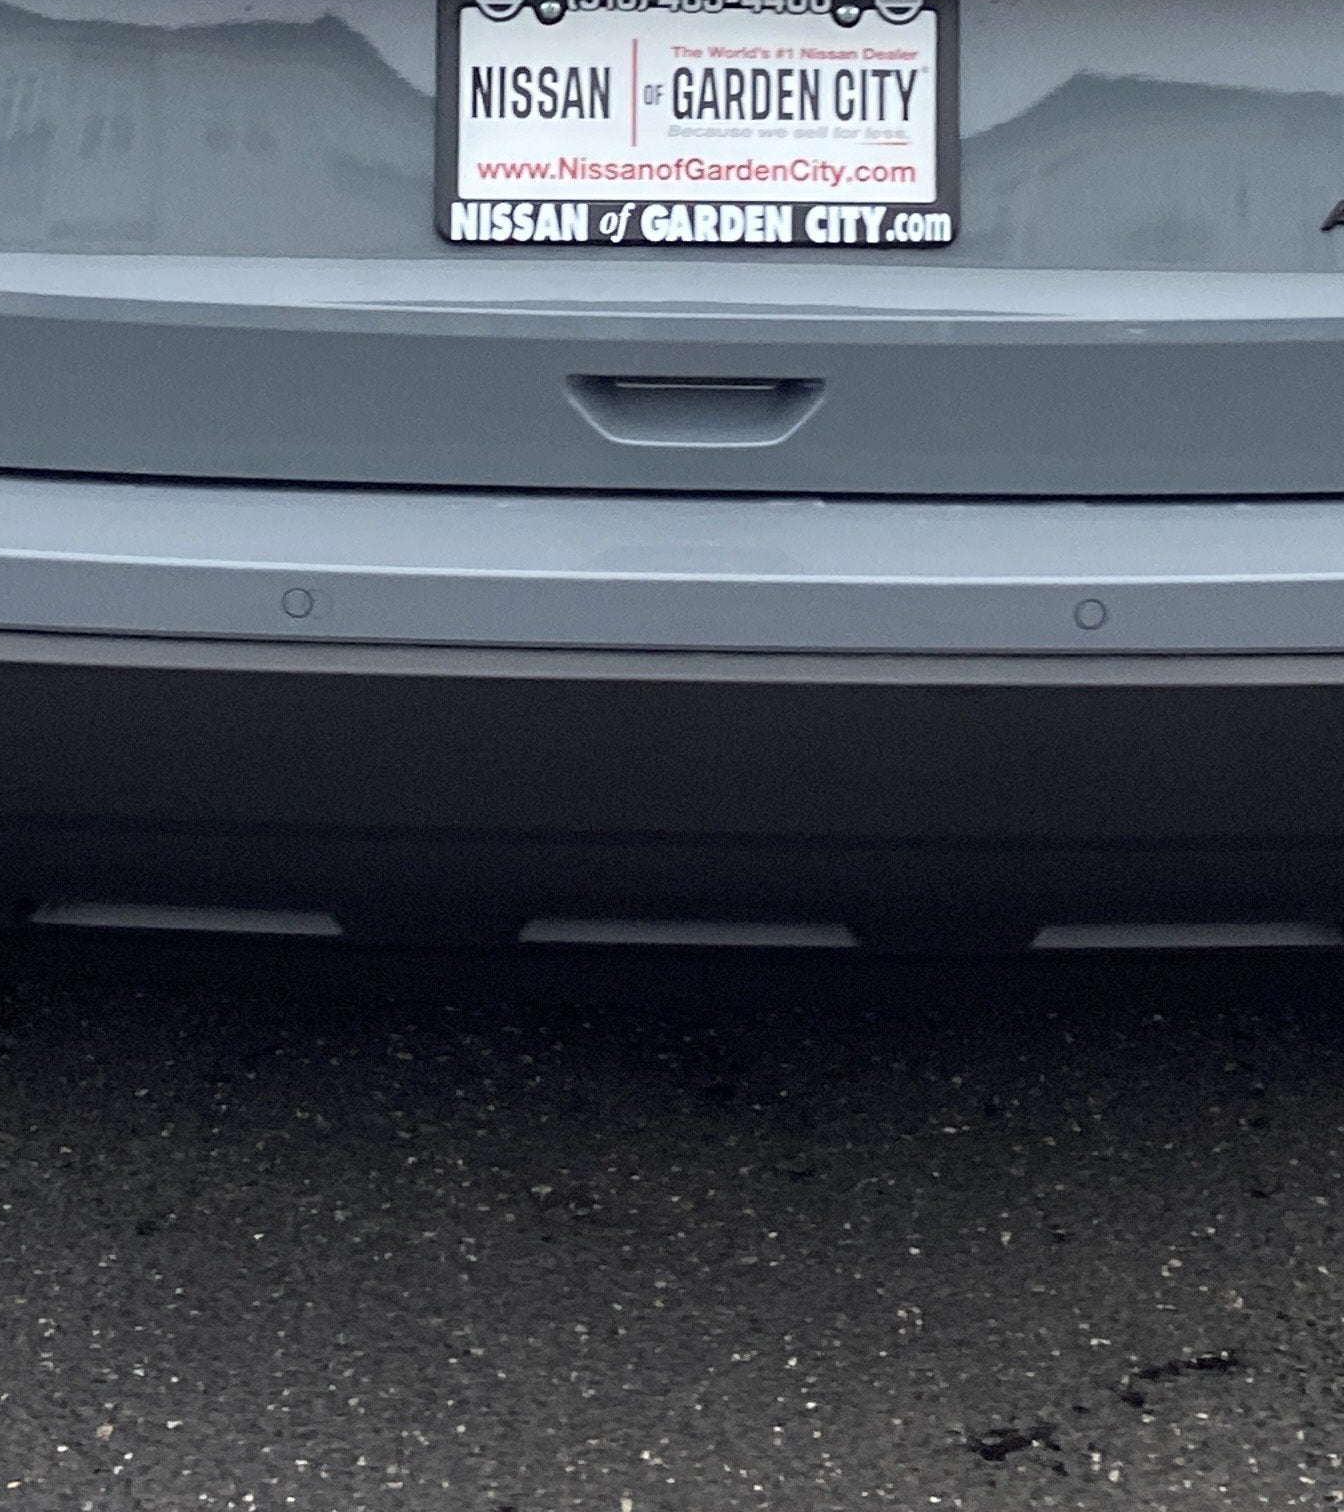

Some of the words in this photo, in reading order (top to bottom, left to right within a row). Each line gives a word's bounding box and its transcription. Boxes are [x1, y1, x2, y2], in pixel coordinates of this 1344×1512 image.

[671, 46, 702, 58] The
[707, 46, 769, 60] World's
[775, 47, 794, 59] #1
[800, 48, 858, 60] Nissan
[862, 48, 918, 61] Dealer
[471, 66, 610, 119] NISSAN
[643, 84, 664, 105] OF
[672, 67, 820, 120] GARDEN
[834, 68, 918, 121] CITY
[667, 124, 753, 138] Because
[759, 128, 789, 138] we
[794, 126, 829, 138] sell
[833, 126, 860, 139] for
[477, 157, 916, 187] www.NissanofGardenCity.com
[451, 202, 588, 242] NISSAN
[599, 202, 634, 244] of
[640, 204, 793, 242] GARDEN
[804, 206, 953, 243] CITY.com
